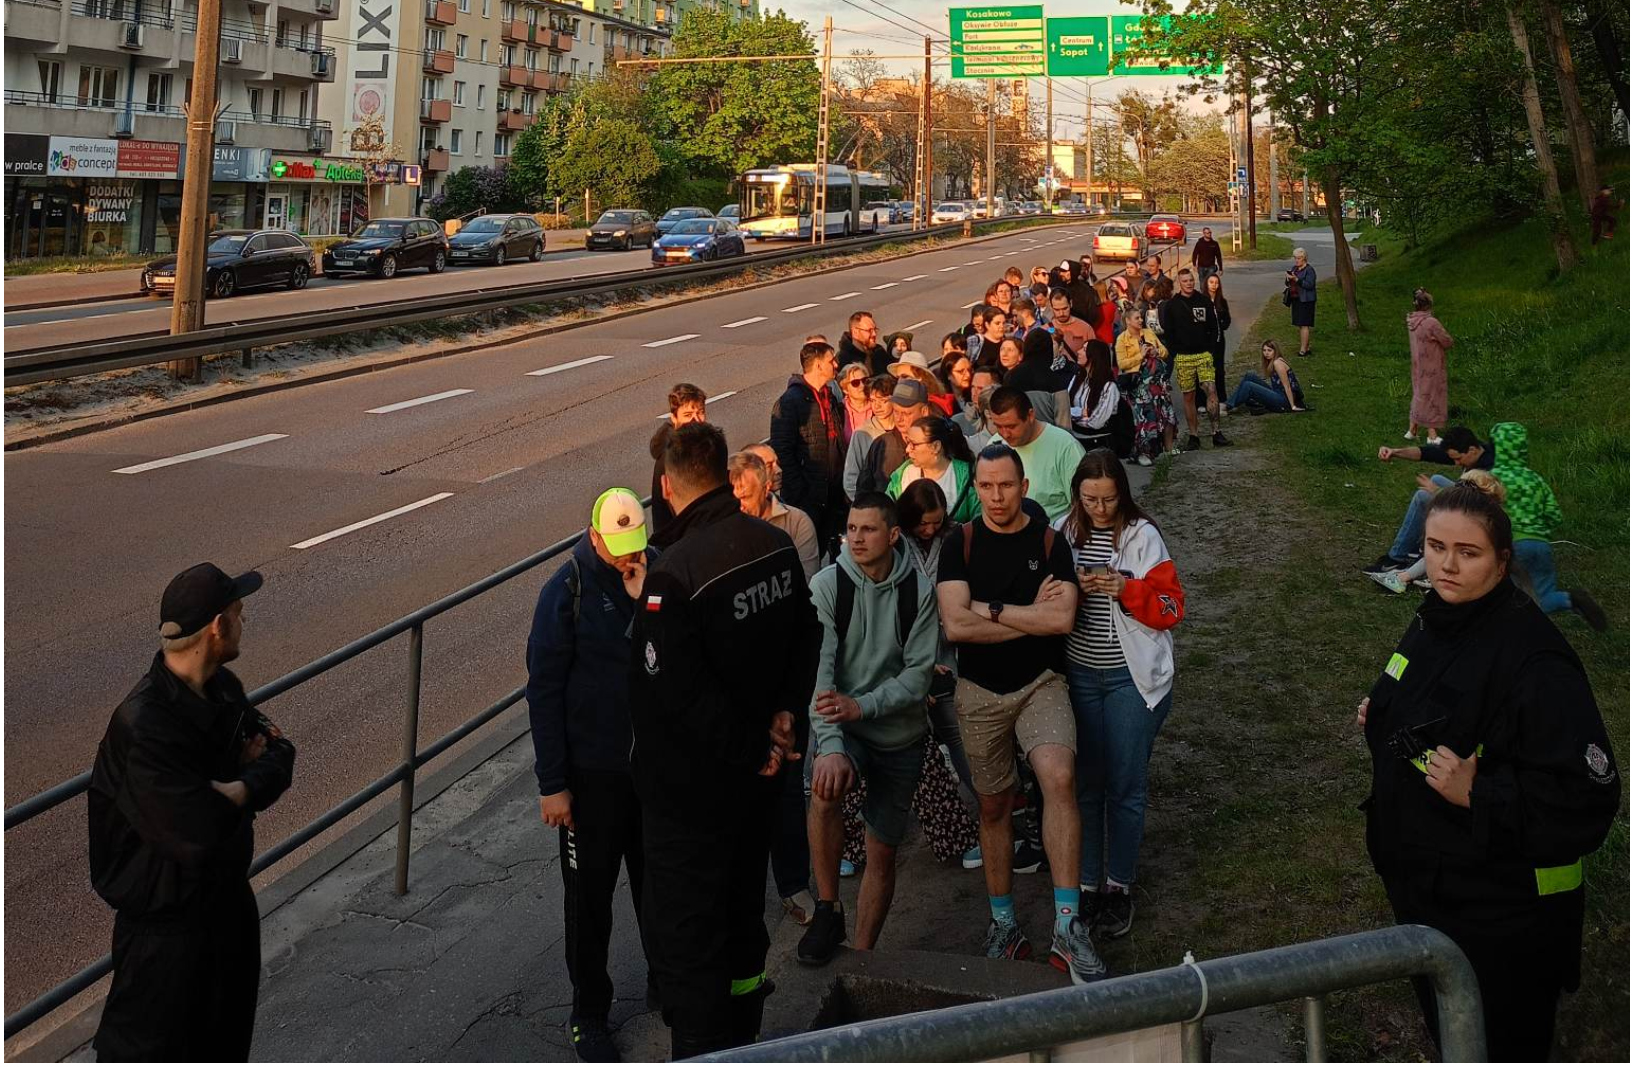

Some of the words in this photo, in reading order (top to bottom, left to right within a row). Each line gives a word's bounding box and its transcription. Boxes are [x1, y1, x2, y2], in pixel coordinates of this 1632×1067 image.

[965, 9, 1012, 18] Kosakowo
[1060, 47, 1088, 58] Sopot
[69, 144, 89, 152] meble
[214, 148, 240, 161] ENKI
[5, 162, 12, 170] w
[78, 156, 116, 170] concept
[326, 163, 363, 183] Apteka
[405, 167, 416, 182] L
[90, 185, 134, 198] DODATKI
[88, 198, 133, 211] DYWANY
[87, 211, 127, 222] BIURKA
